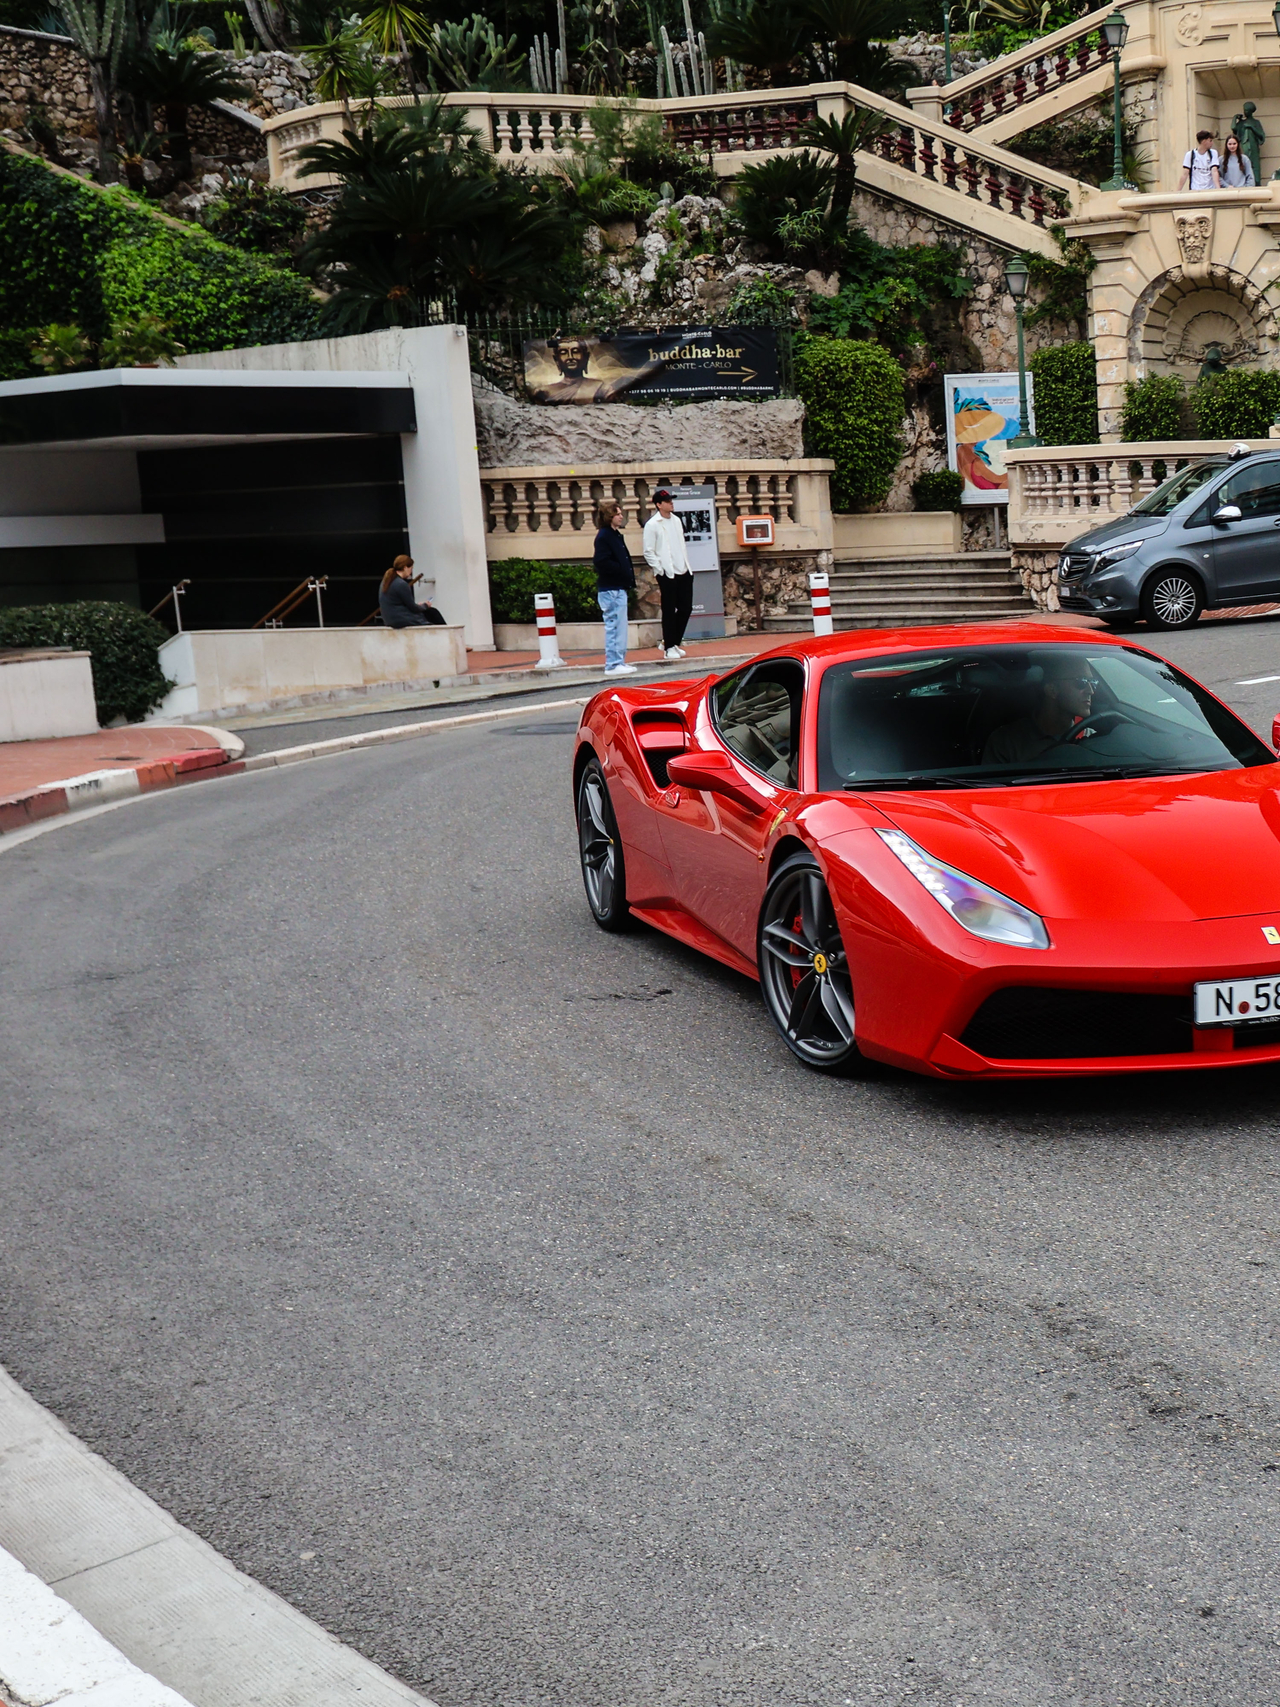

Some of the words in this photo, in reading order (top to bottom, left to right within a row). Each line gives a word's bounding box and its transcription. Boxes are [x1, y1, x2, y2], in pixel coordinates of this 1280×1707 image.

[648, 344, 742, 361] buddha-bar
[665, 362, 696, 370] MONTE
[703, 361, 732, 369] CARLO
[1215, 987, 1234, 1016] N
